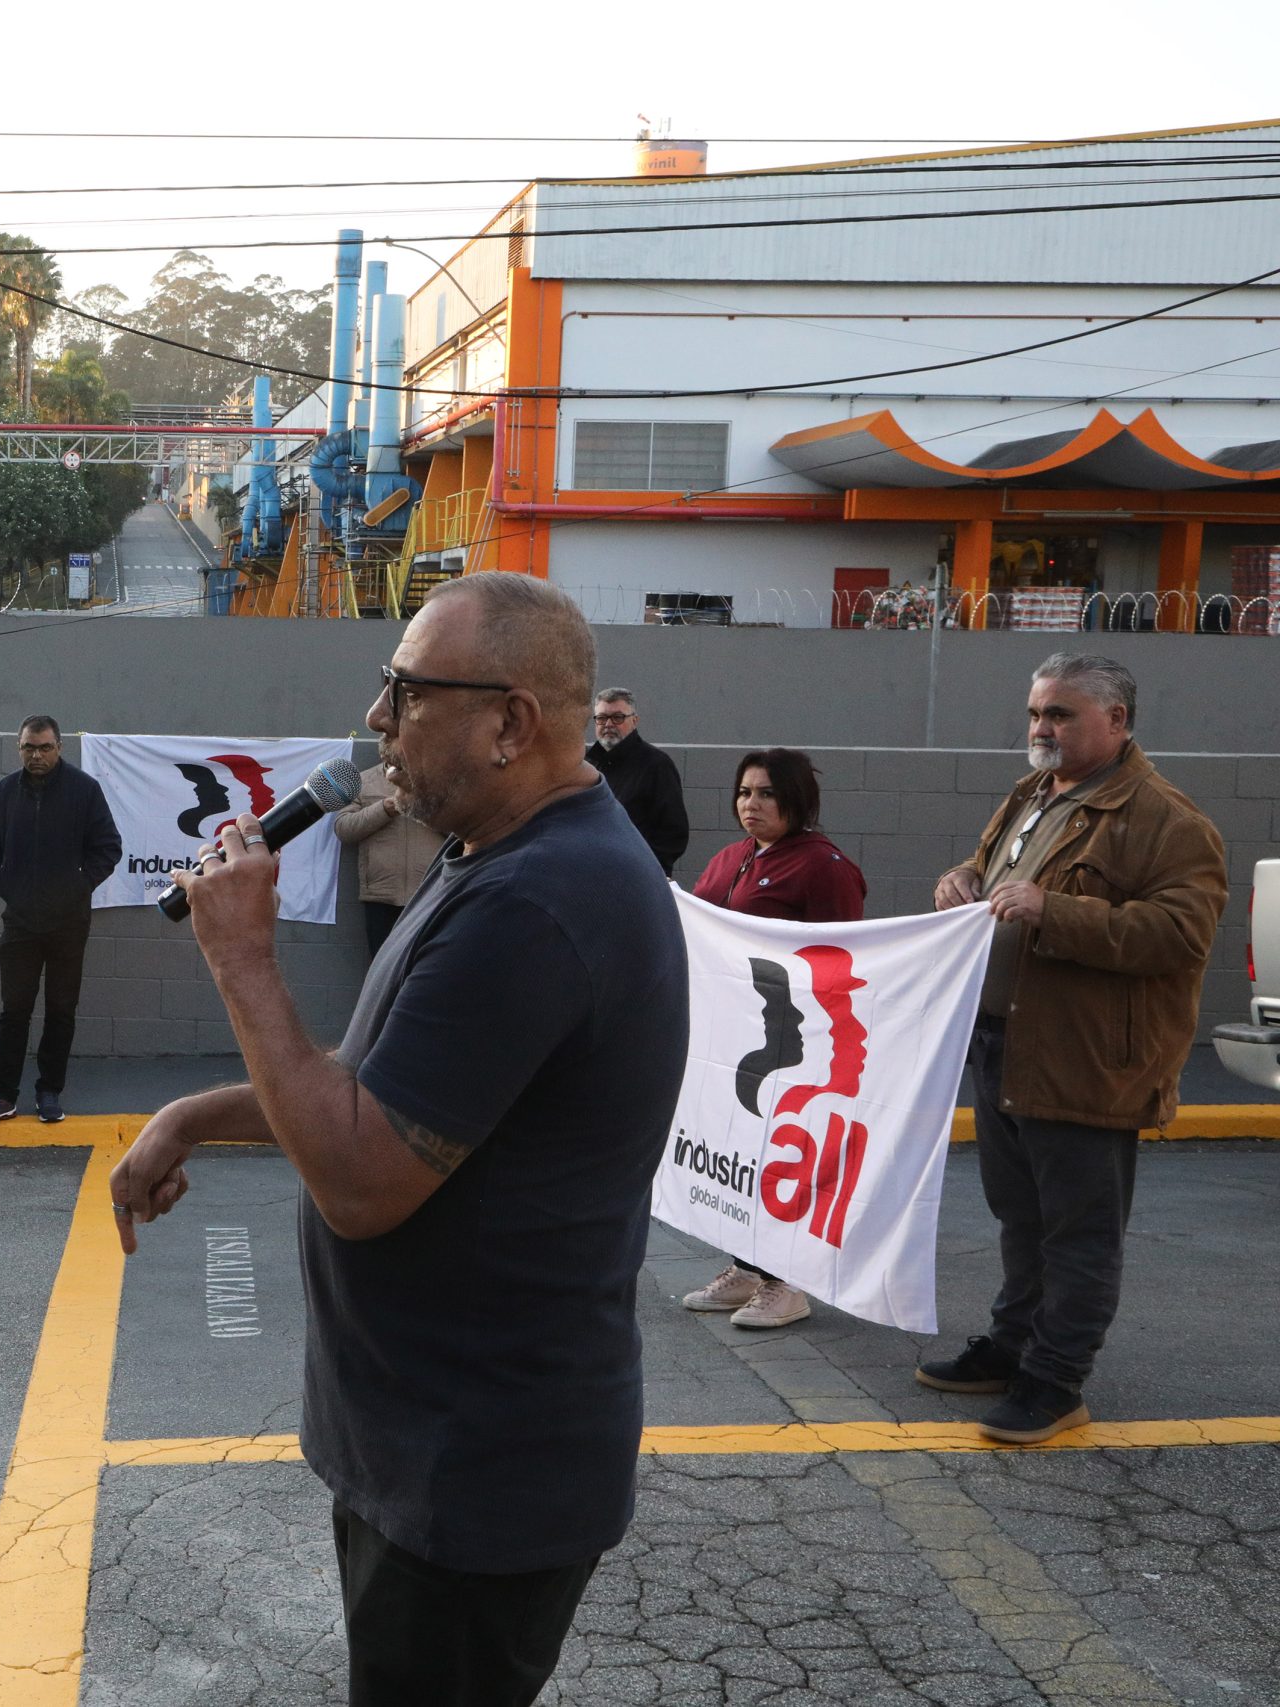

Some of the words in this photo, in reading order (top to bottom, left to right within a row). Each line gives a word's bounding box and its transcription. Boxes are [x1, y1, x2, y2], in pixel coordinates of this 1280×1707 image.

[144, 879, 174, 891] globa
[674, 1128, 757, 1198] industri
[760, 1112, 868, 1249] all
[689, 1184, 720, 1211] global
[721, 1199, 751, 1227] union
